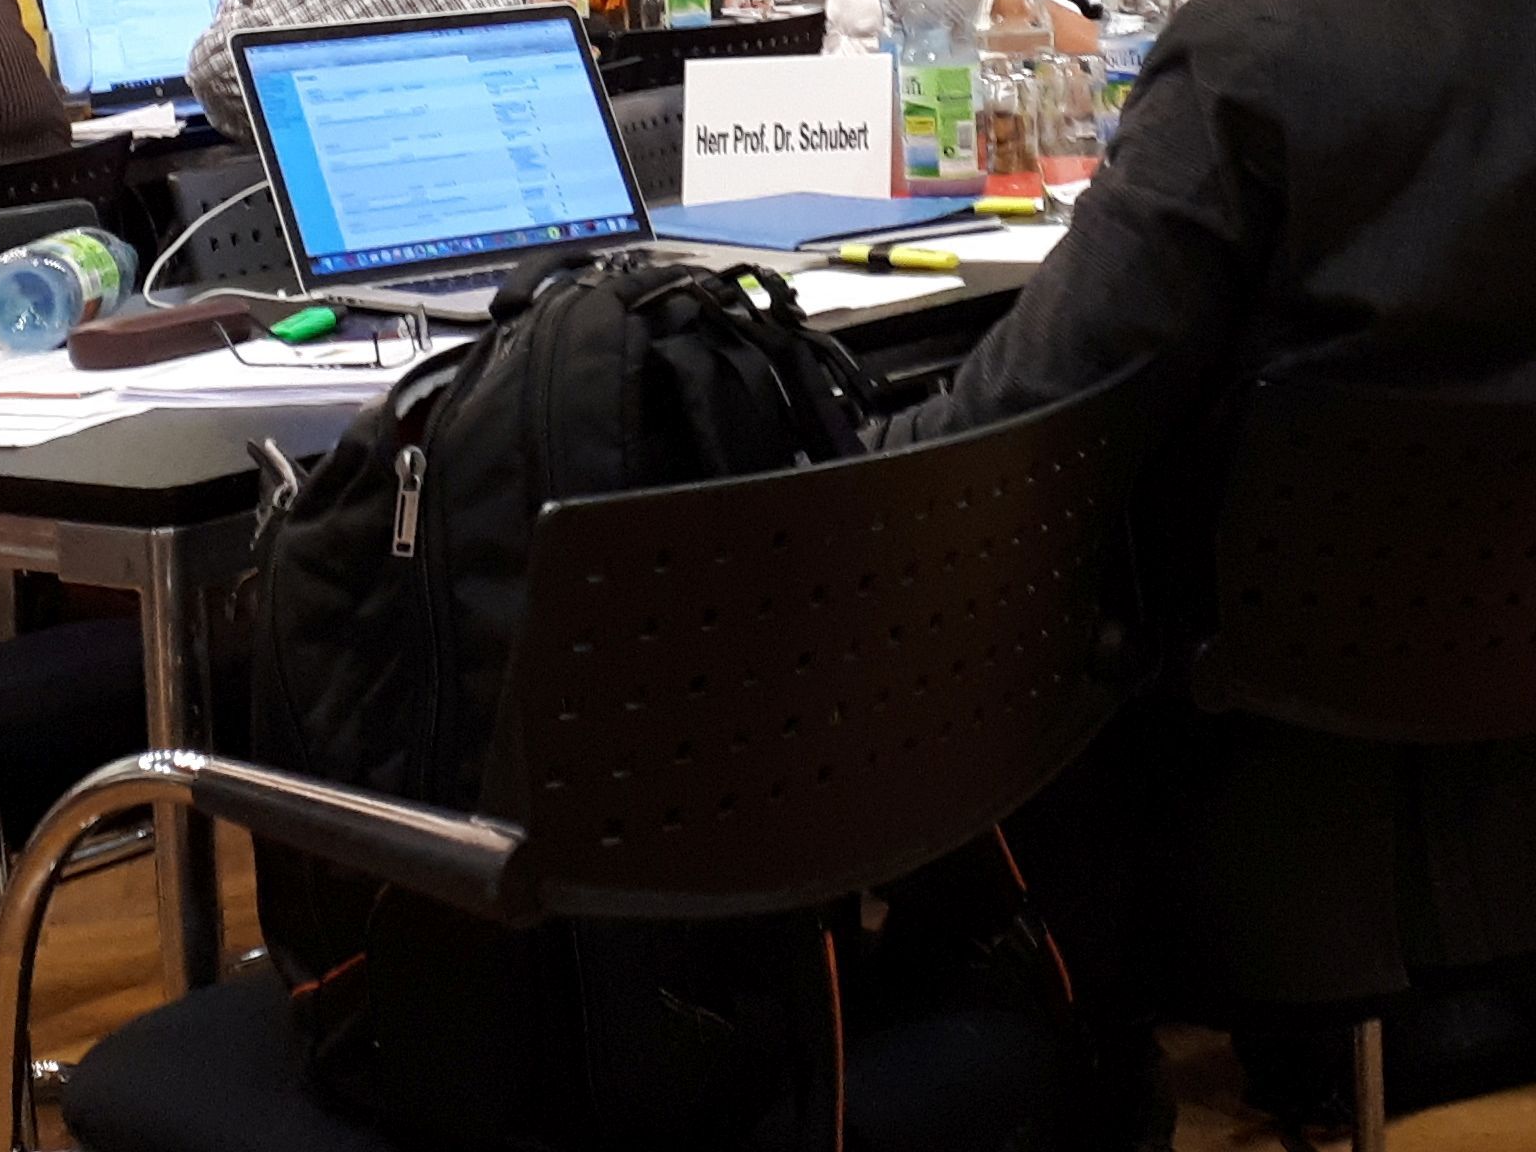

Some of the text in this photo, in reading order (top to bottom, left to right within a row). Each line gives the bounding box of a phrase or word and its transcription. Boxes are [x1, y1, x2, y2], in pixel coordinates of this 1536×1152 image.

[696, 119, 870, 155] Herr Prof. Dr. Schubert
